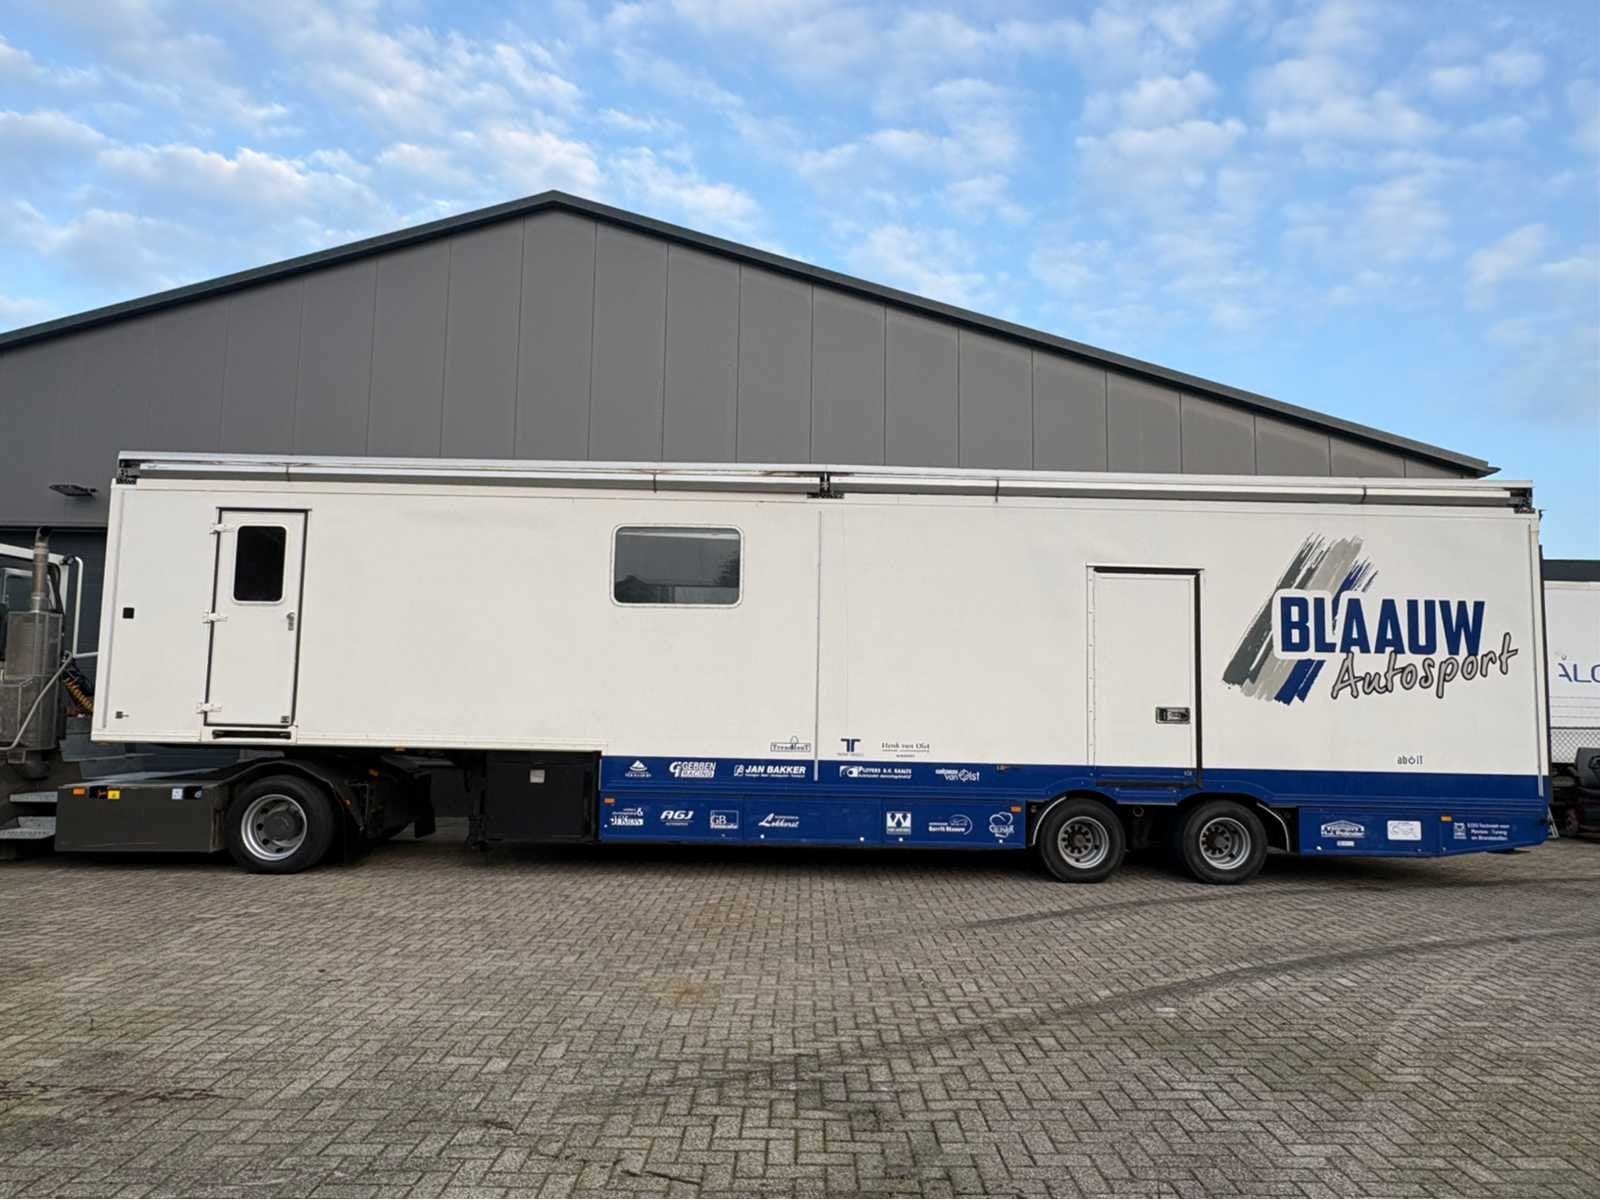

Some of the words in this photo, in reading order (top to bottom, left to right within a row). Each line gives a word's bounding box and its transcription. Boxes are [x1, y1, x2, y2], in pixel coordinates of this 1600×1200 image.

[1280, 597, 1485, 656] BLAAUW
[1331, 632, 1519, 699] Autosport
[745, 764, 766, 774] JAN
[767, 765, 806, 775] BAKKER
